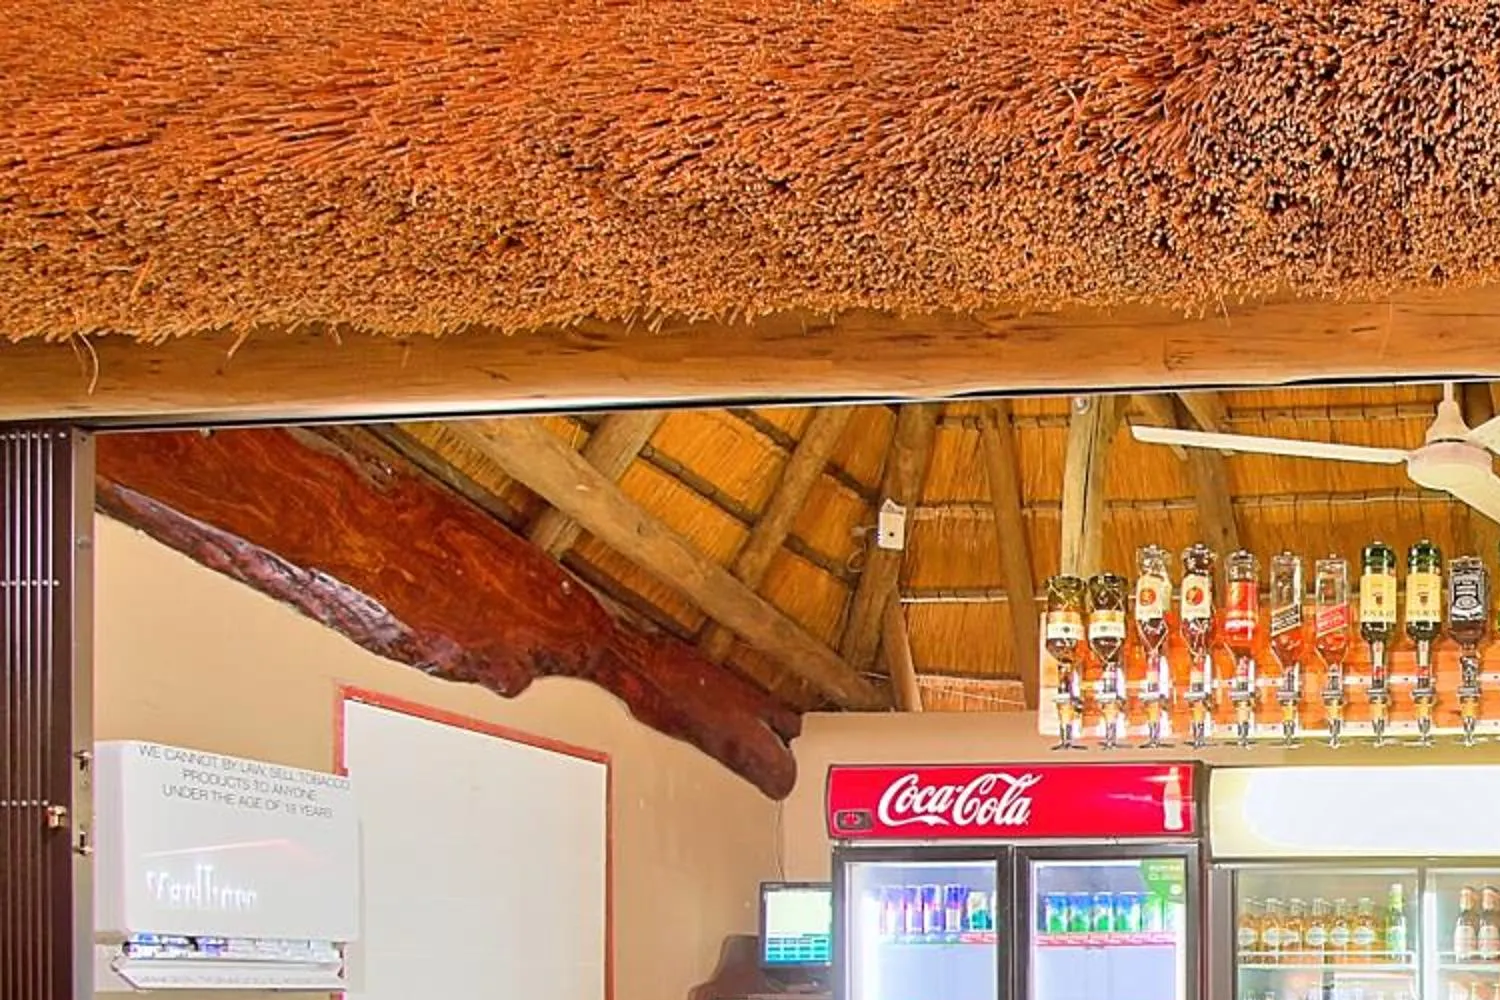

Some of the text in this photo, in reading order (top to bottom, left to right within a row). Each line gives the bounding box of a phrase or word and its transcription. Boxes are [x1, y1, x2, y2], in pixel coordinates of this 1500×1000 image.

[138, 744, 161, 759] WE
[163, 747, 219, 768] CANNOT
[162, 783, 208, 801] UNDER
[212, 791, 237, 806] THE
[239, 796, 262, 809] AGE
[264, 799, 281, 811] OF
[299, 803, 333, 819] YEARS
[182, 769, 318, 801] PRODUCTS TO ANYONE
